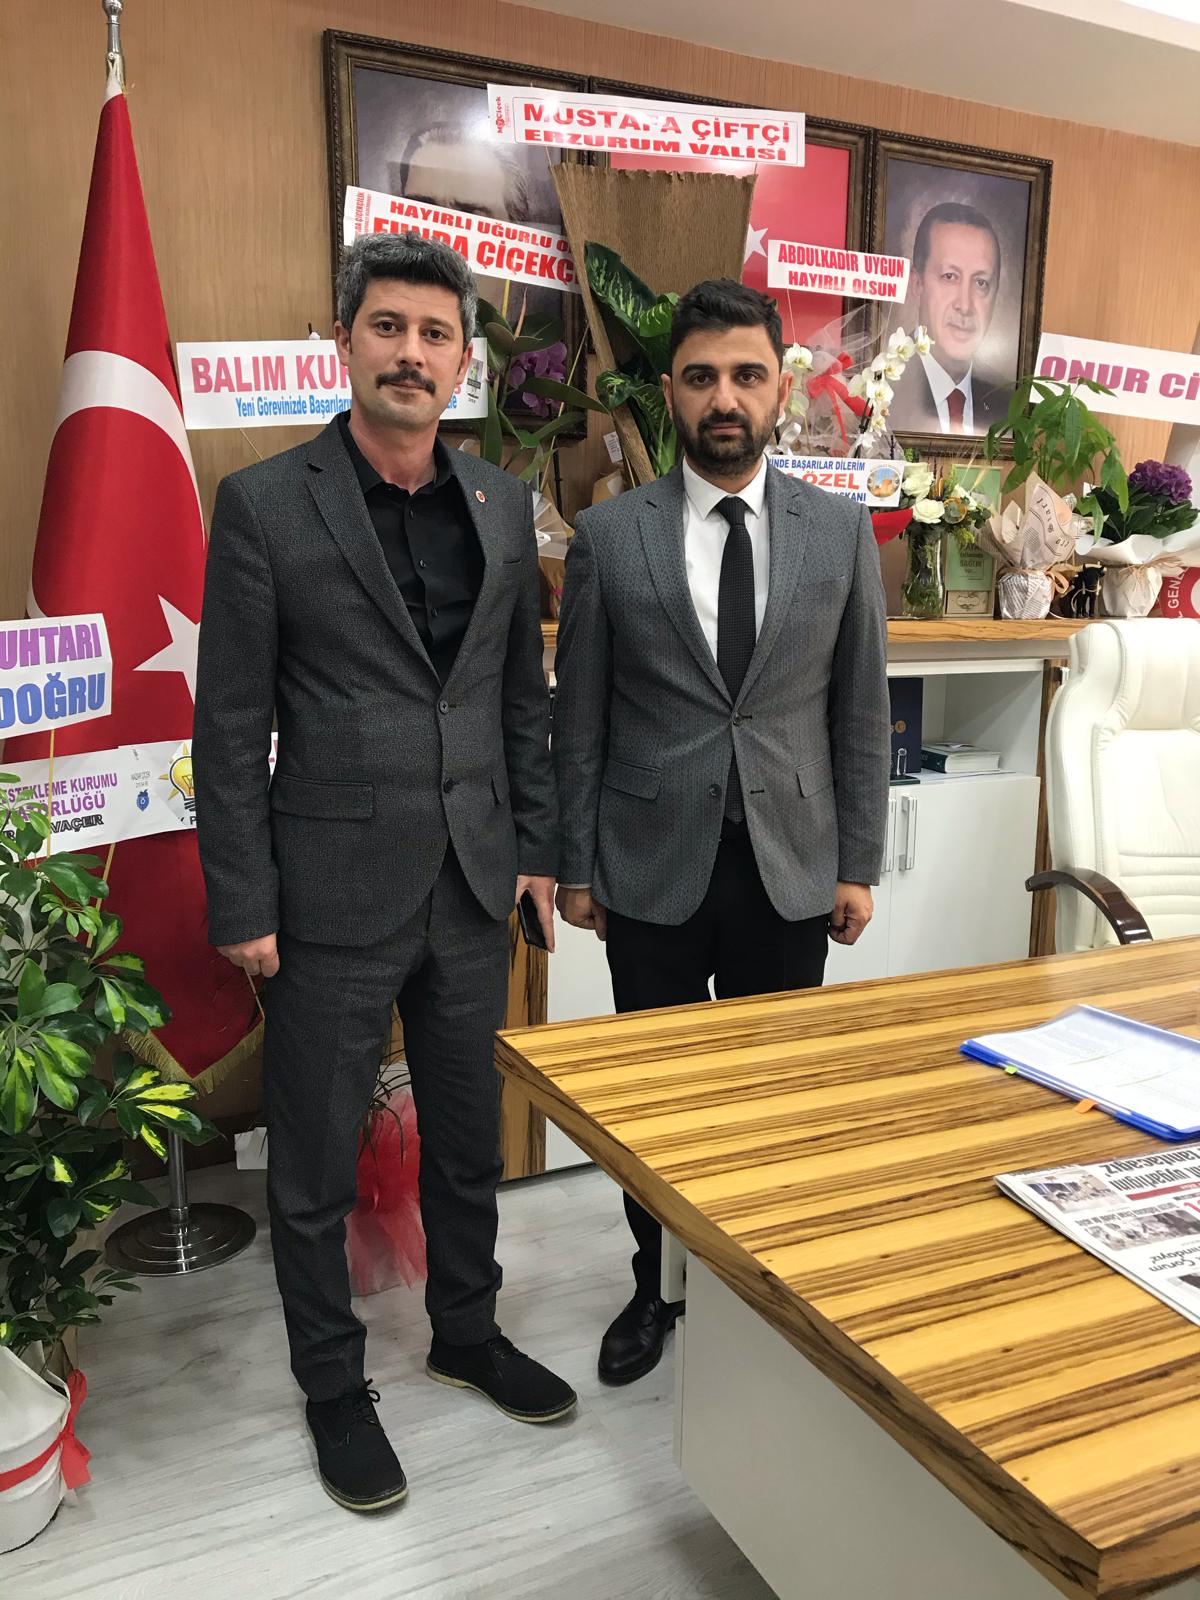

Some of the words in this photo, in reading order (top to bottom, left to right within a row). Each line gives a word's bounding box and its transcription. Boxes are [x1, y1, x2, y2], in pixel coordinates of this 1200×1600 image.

[524, 129, 680, 153] ERZURUM
[688, 142, 786, 161] VALİSİ
[691, 115, 790, 145] ÇİFTÇİ
[390, 201, 472, 230] HAYIRLI
[477, 221, 552, 249] UĞURLU
[778, 243, 859, 272] ABDULKADİR
[865, 255, 904, 278] UYGUN
[788, 270, 846, 291] HAYIRLI
[852, 278, 897, 297] OLSUN
[191, 356, 286, 393] BALIM
[1040, 356, 1150, 394] ONUR
[236, 396, 255, 417] Yeni
[257, 395, 307, 416] Görevinizde
[769, 455, 789, 469] İNDE
[791, 459, 833, 472] BAŞARILAR
[835, 460, 865, 471] DİLERİM
[802, 471, 860, 490] ÖZEL
[0, 623, 102, 670] UHTARI
[0, 672, 106, 729] DOĞRU
[70, 772, 118, 793] KURUMU
